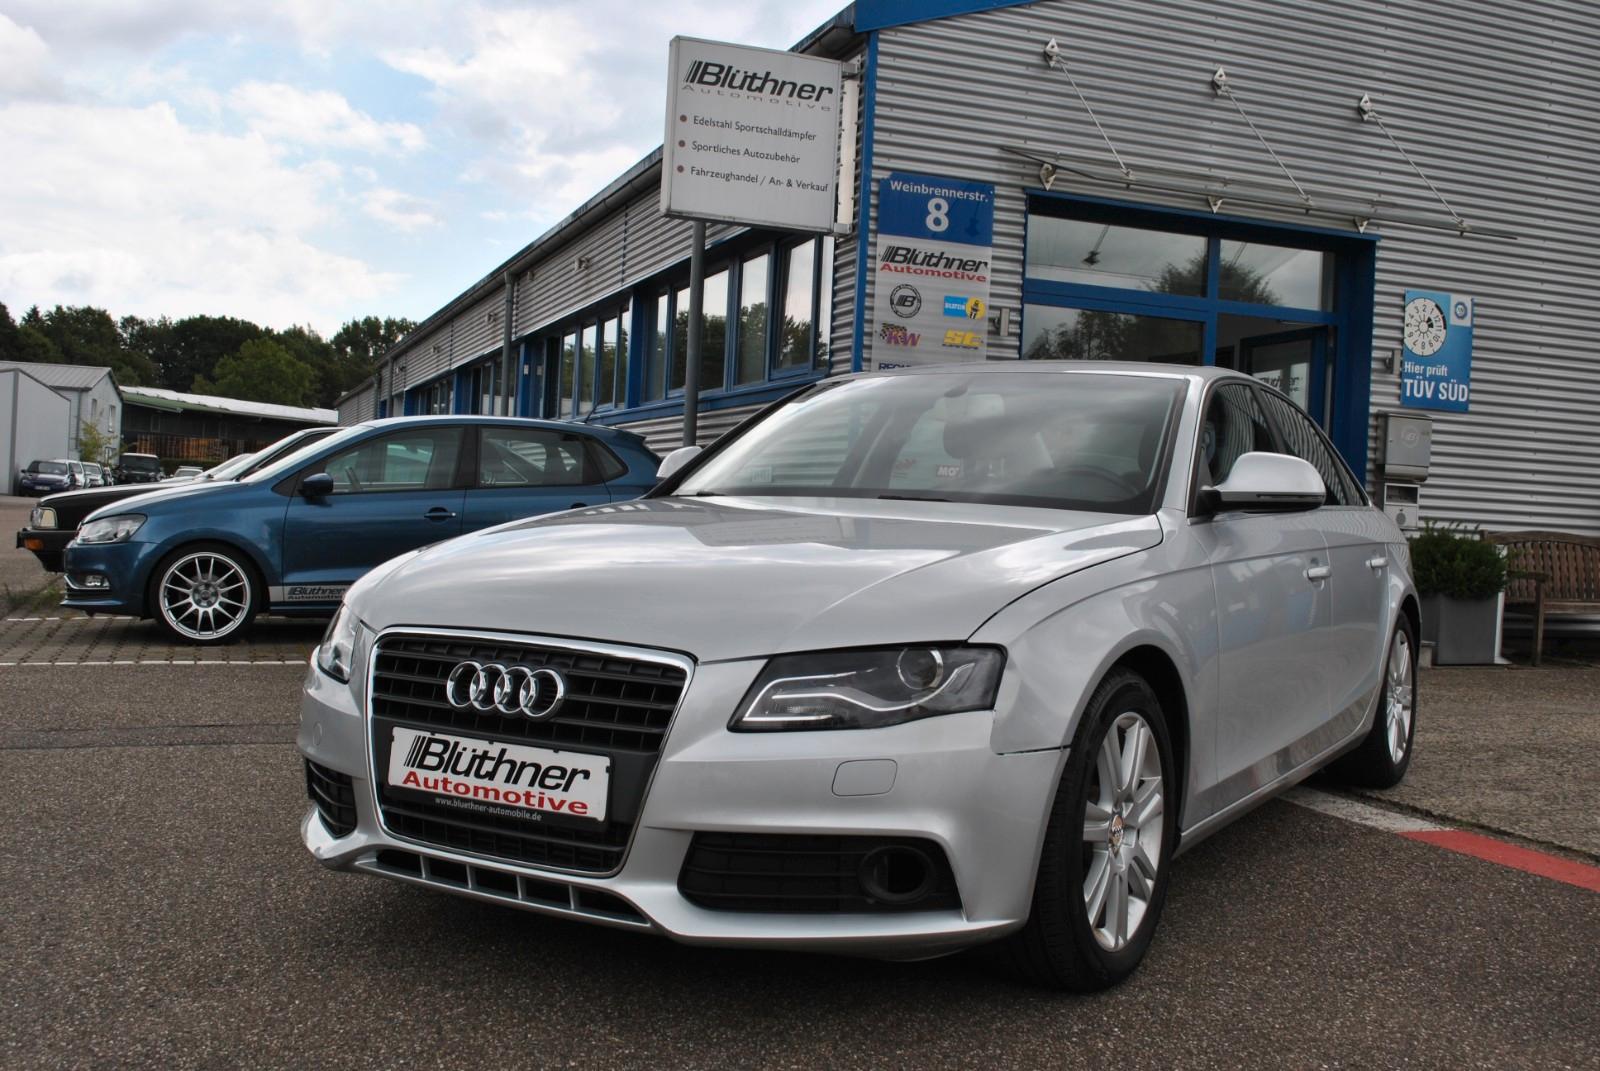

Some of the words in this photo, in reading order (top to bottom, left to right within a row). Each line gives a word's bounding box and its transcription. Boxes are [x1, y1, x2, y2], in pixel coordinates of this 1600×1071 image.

[692, 60, 834, 102] Blüthner
[681, 84, 832, 112] Automotive
[693, 115, 732, 129] Edelstahl
[734, 121, 817, 141] Sportschalldämpfer
[691, 140, 741, 156] Sportliches
[743, 147, 801, 164] Autozubehör
[690, 166, 759, 183] Fahrzeughandel
[768, 176, 784, 186] An-
[786, 179, 793, 188] &
[796, 180, 829, 193] Verkauf
[890, 180, 989, 203] Weinbrennerstr.
[925, 197, 949, 233] 8
[884, 246, 988, 273] Blüthner
[879, 263, 987, 283] Automotive
[1404, 361, 1425, 374] Hier
[1426, 363, 1448, 377] prüft
[1404, 376, 1436, 399] TÜV
[1438, 379, 1468, 402] SÜD
[410, 736, 591, 793] Blüthner
[402, 771, 588, 815] Automotive
[434, 797, 542, 822] www.bluethner-automobile.de
